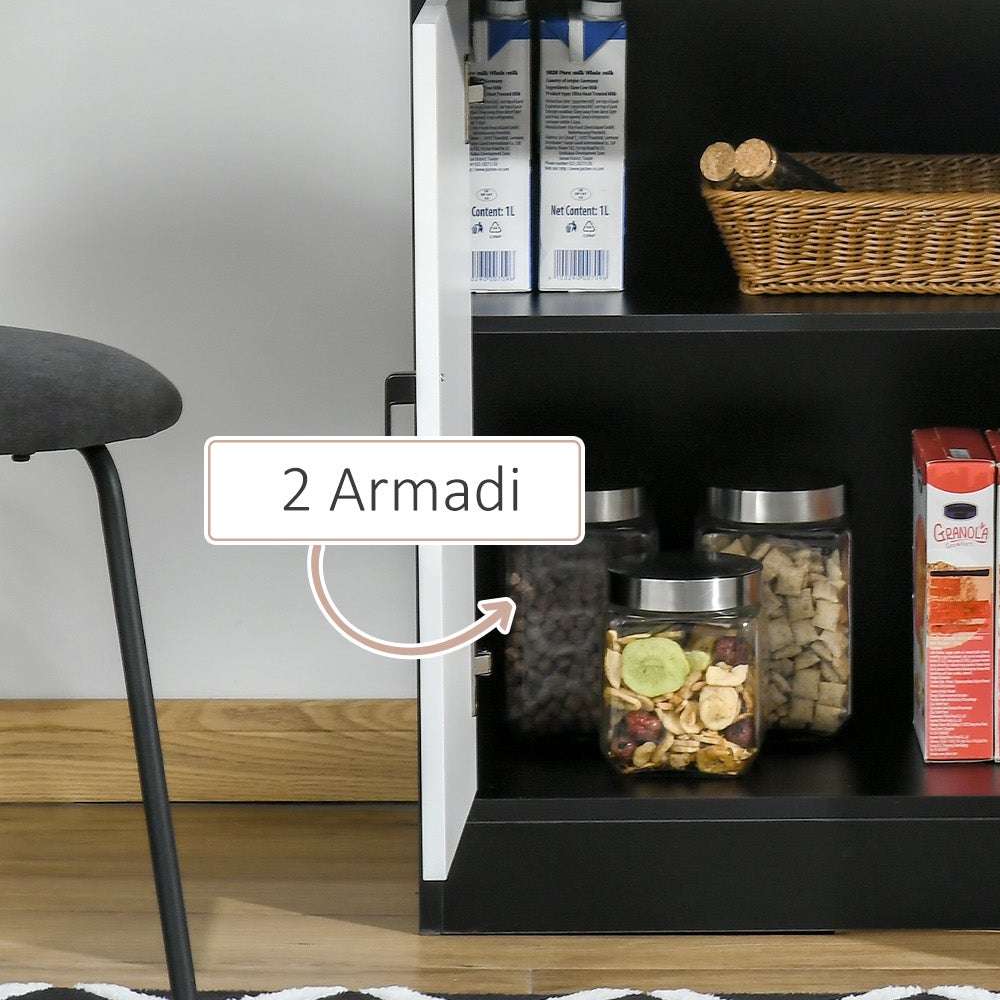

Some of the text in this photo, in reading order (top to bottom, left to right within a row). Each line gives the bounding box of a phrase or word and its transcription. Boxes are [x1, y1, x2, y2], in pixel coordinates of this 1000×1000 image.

[471, 206, 503, 217] Content:
[551, 205, 564, 216] Net
[565, 205, 598, 216] Content:
[933, 523, 989, 542] GRANOLA
